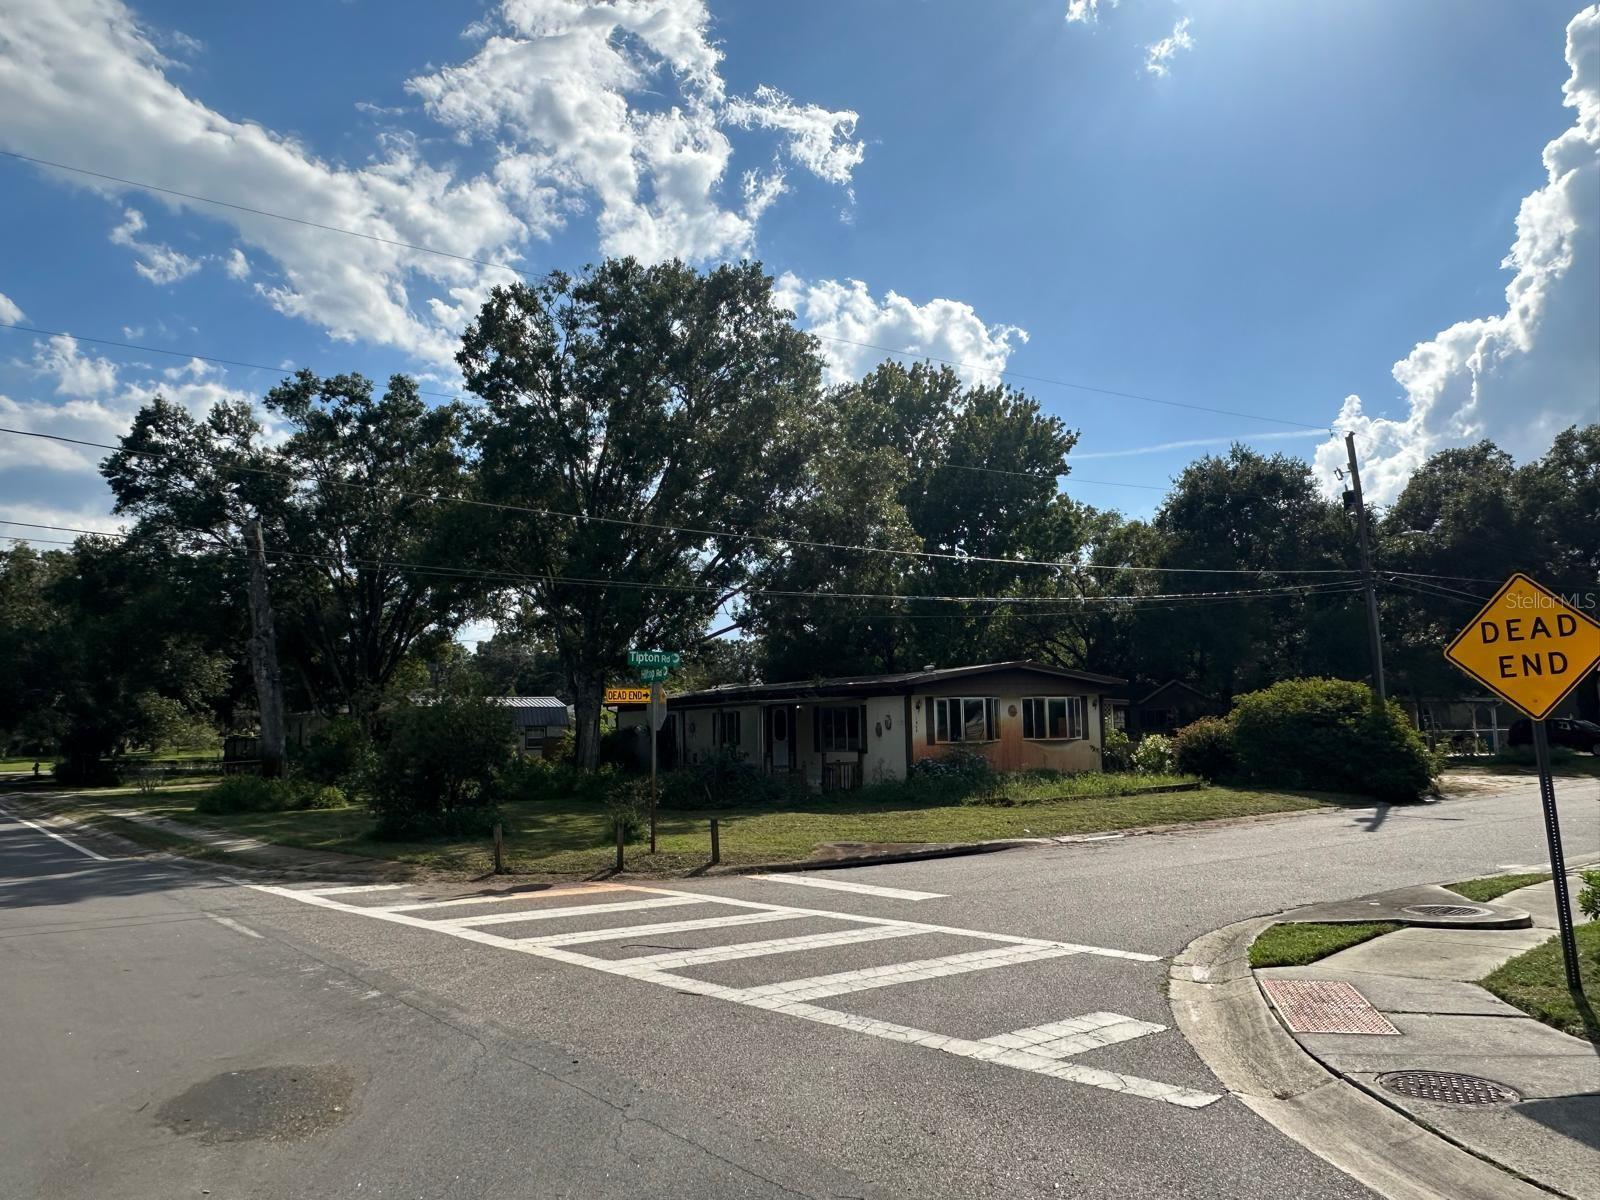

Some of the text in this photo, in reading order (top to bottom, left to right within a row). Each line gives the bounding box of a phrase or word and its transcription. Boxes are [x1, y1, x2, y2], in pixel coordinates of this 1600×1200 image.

[1480, 614, 1577, 644] DEAD
[629, 651, 671, 664] Tipton Rd
[1498, 651, 1568, 679] END
[608, 690, 643, 701] DEAD END
